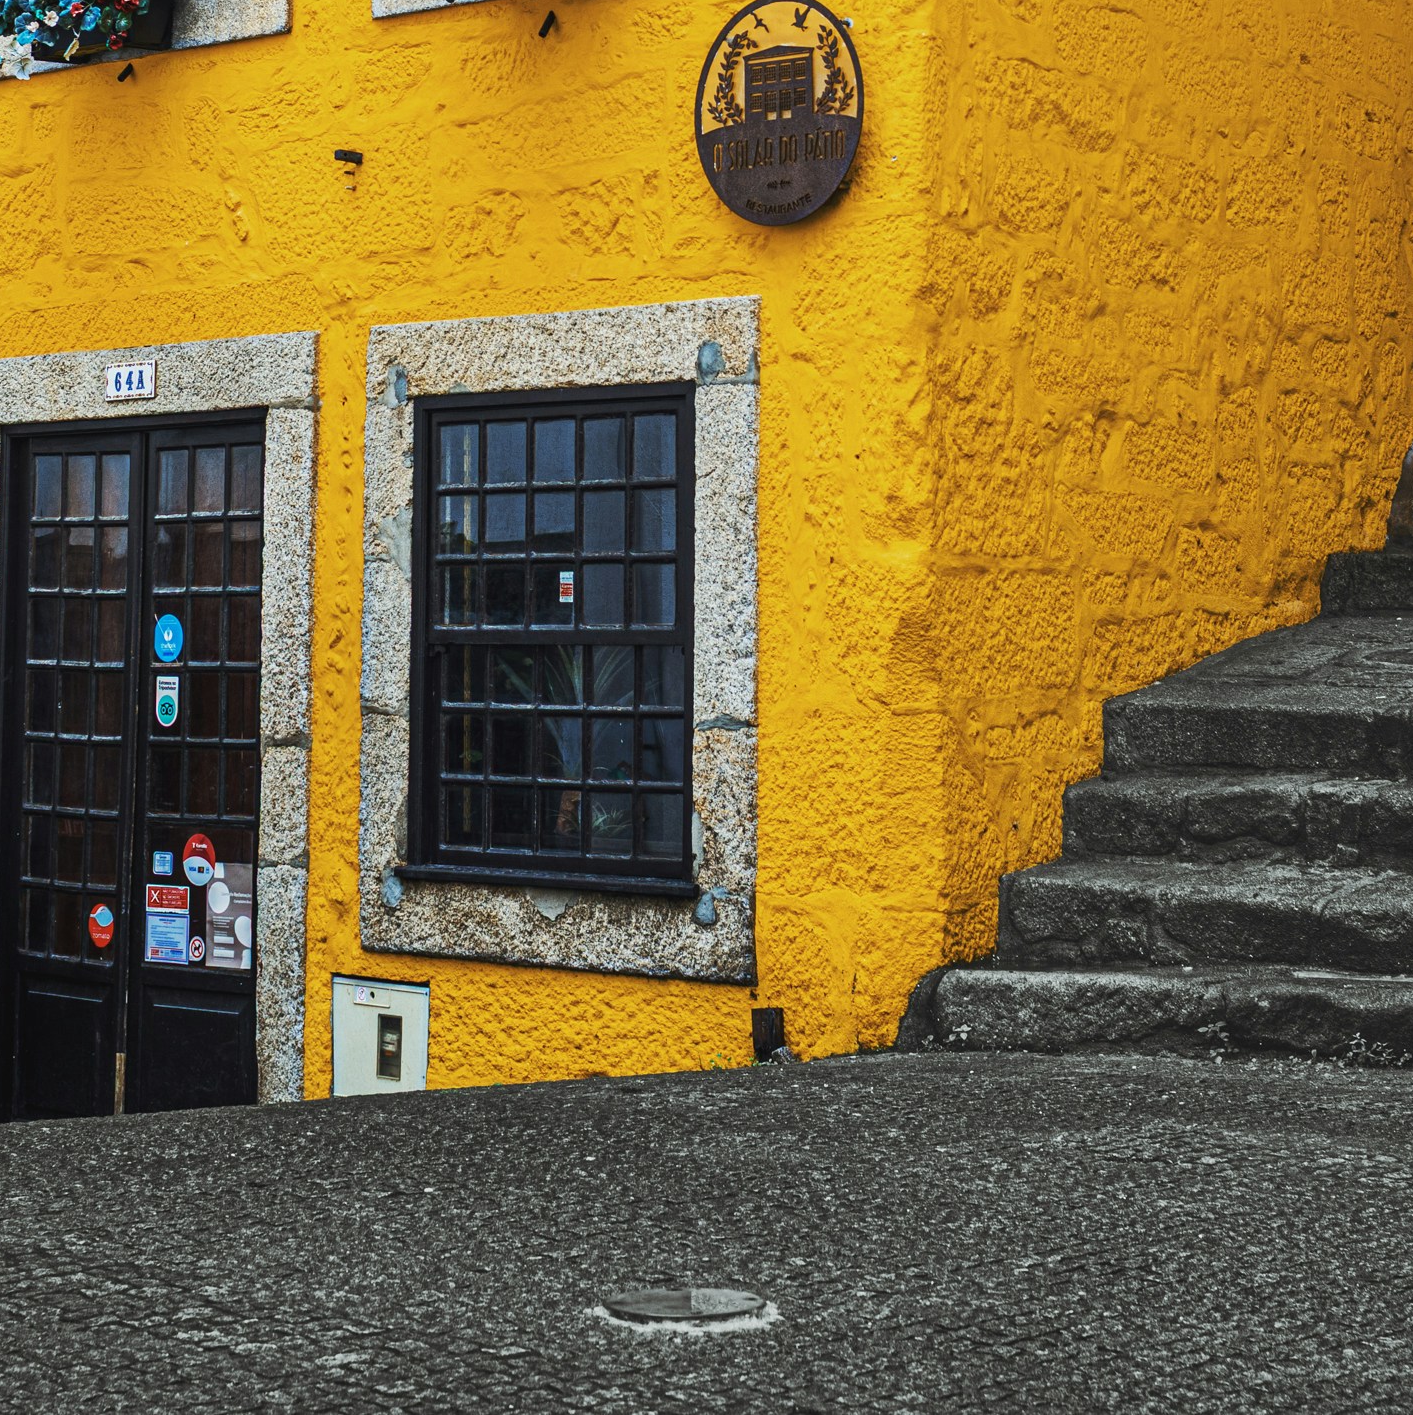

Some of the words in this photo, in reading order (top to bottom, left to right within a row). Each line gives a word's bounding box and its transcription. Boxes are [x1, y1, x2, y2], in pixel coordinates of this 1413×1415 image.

[713, 143, 723, 173] O
[728, 138, 774, 171] SOLAR
[779, 134, 797, 165] DO
[804, 126, 846, 162] PÁTIO
[746, 193, 812, 214] RESTAURANTE
[115, 370, 145, 392] 64A
